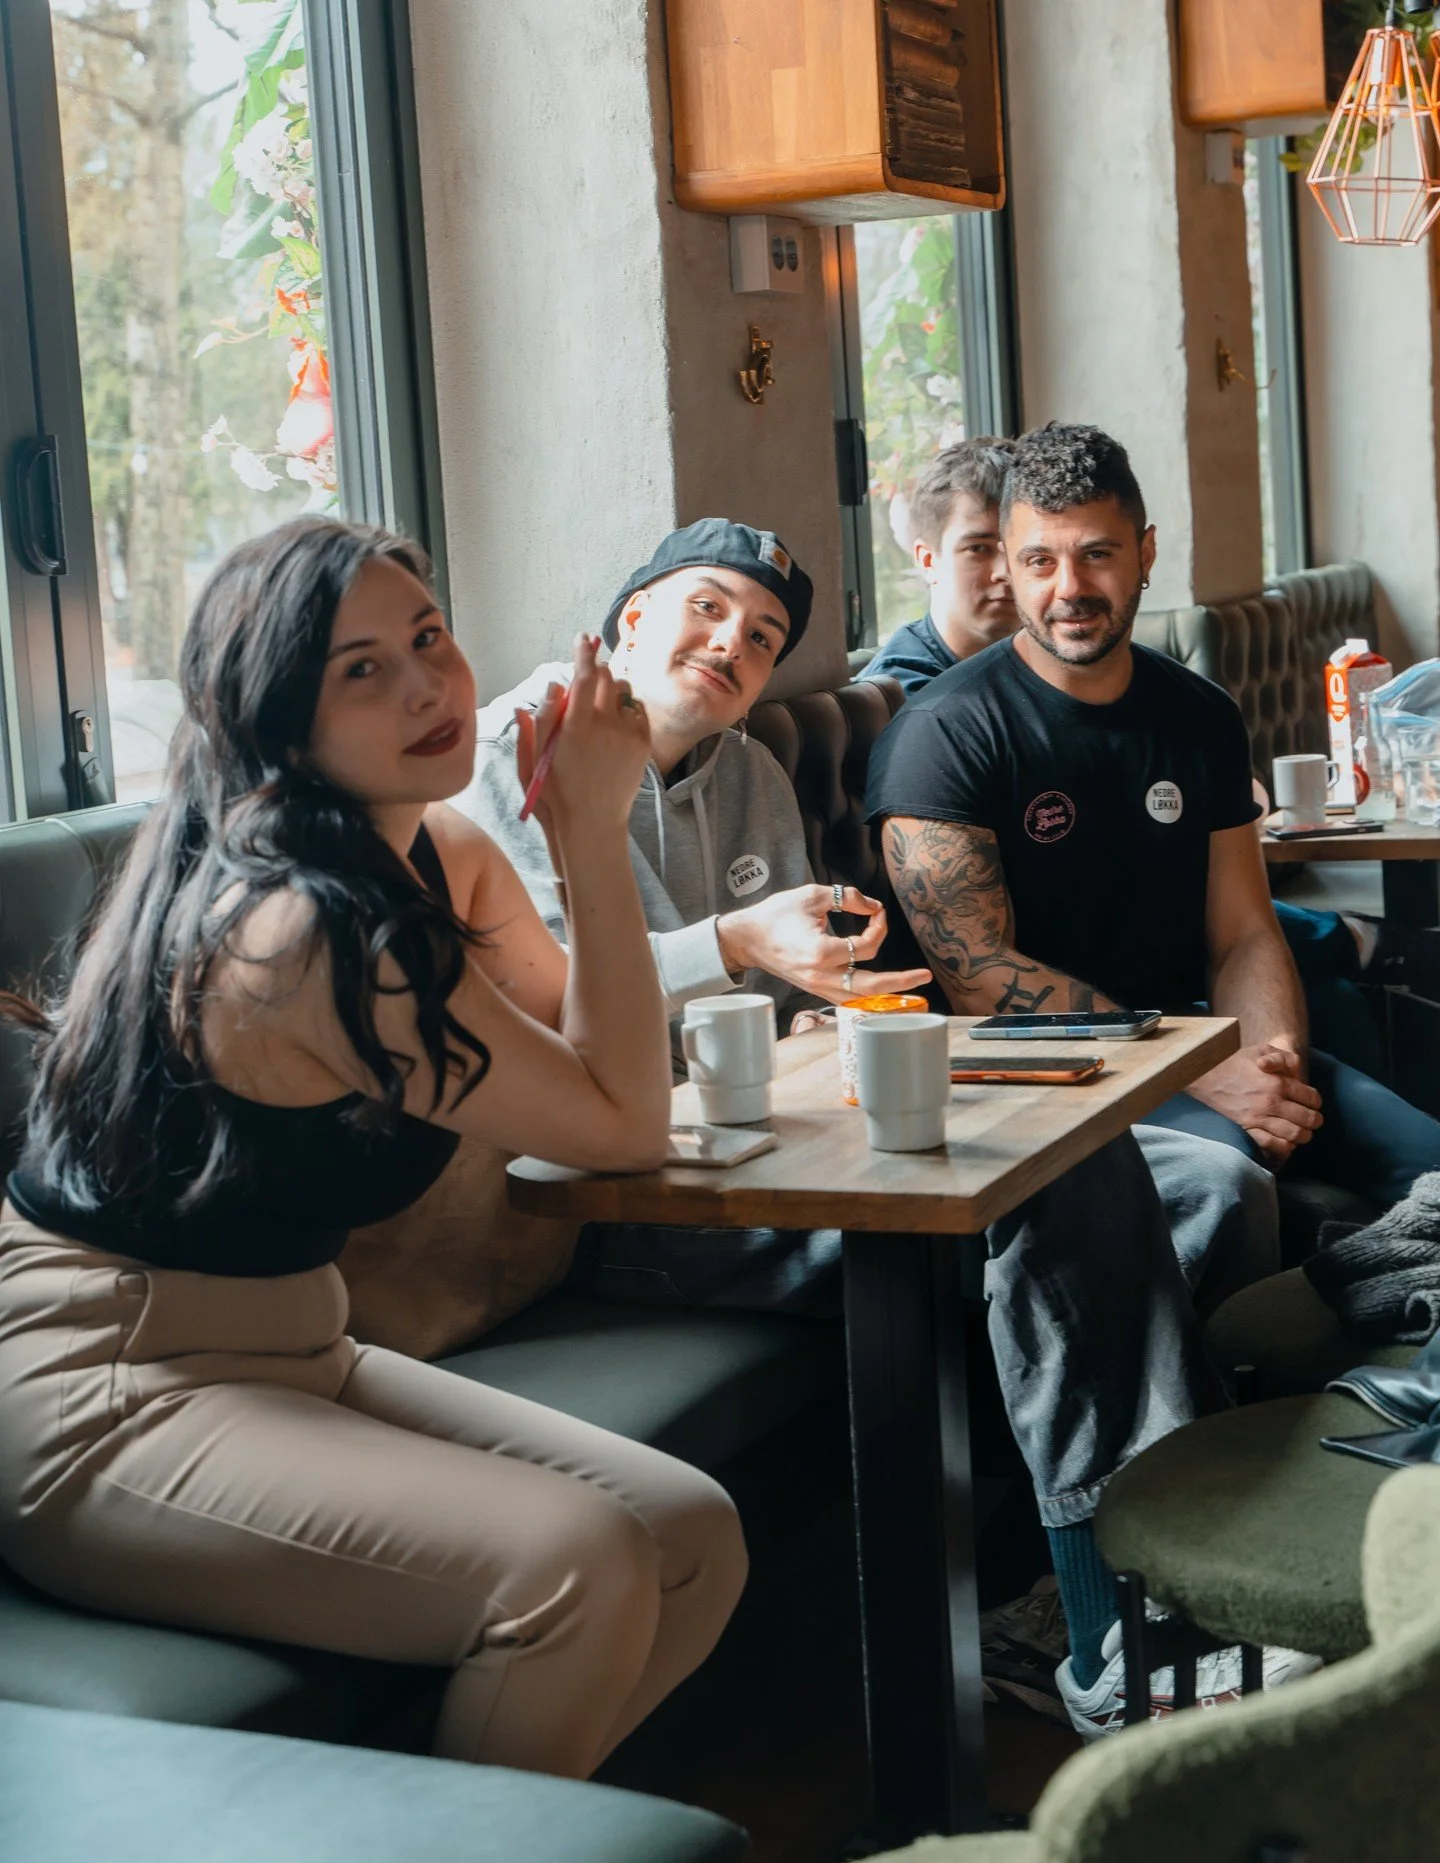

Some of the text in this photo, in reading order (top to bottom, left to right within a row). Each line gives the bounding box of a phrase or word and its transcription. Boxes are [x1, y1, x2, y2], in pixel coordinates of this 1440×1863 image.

[1153, 788, 1176, 798] NEDRE
[730, 859, 756, 878] NEDRE
[733, 867, 764, 888] LØKKA
